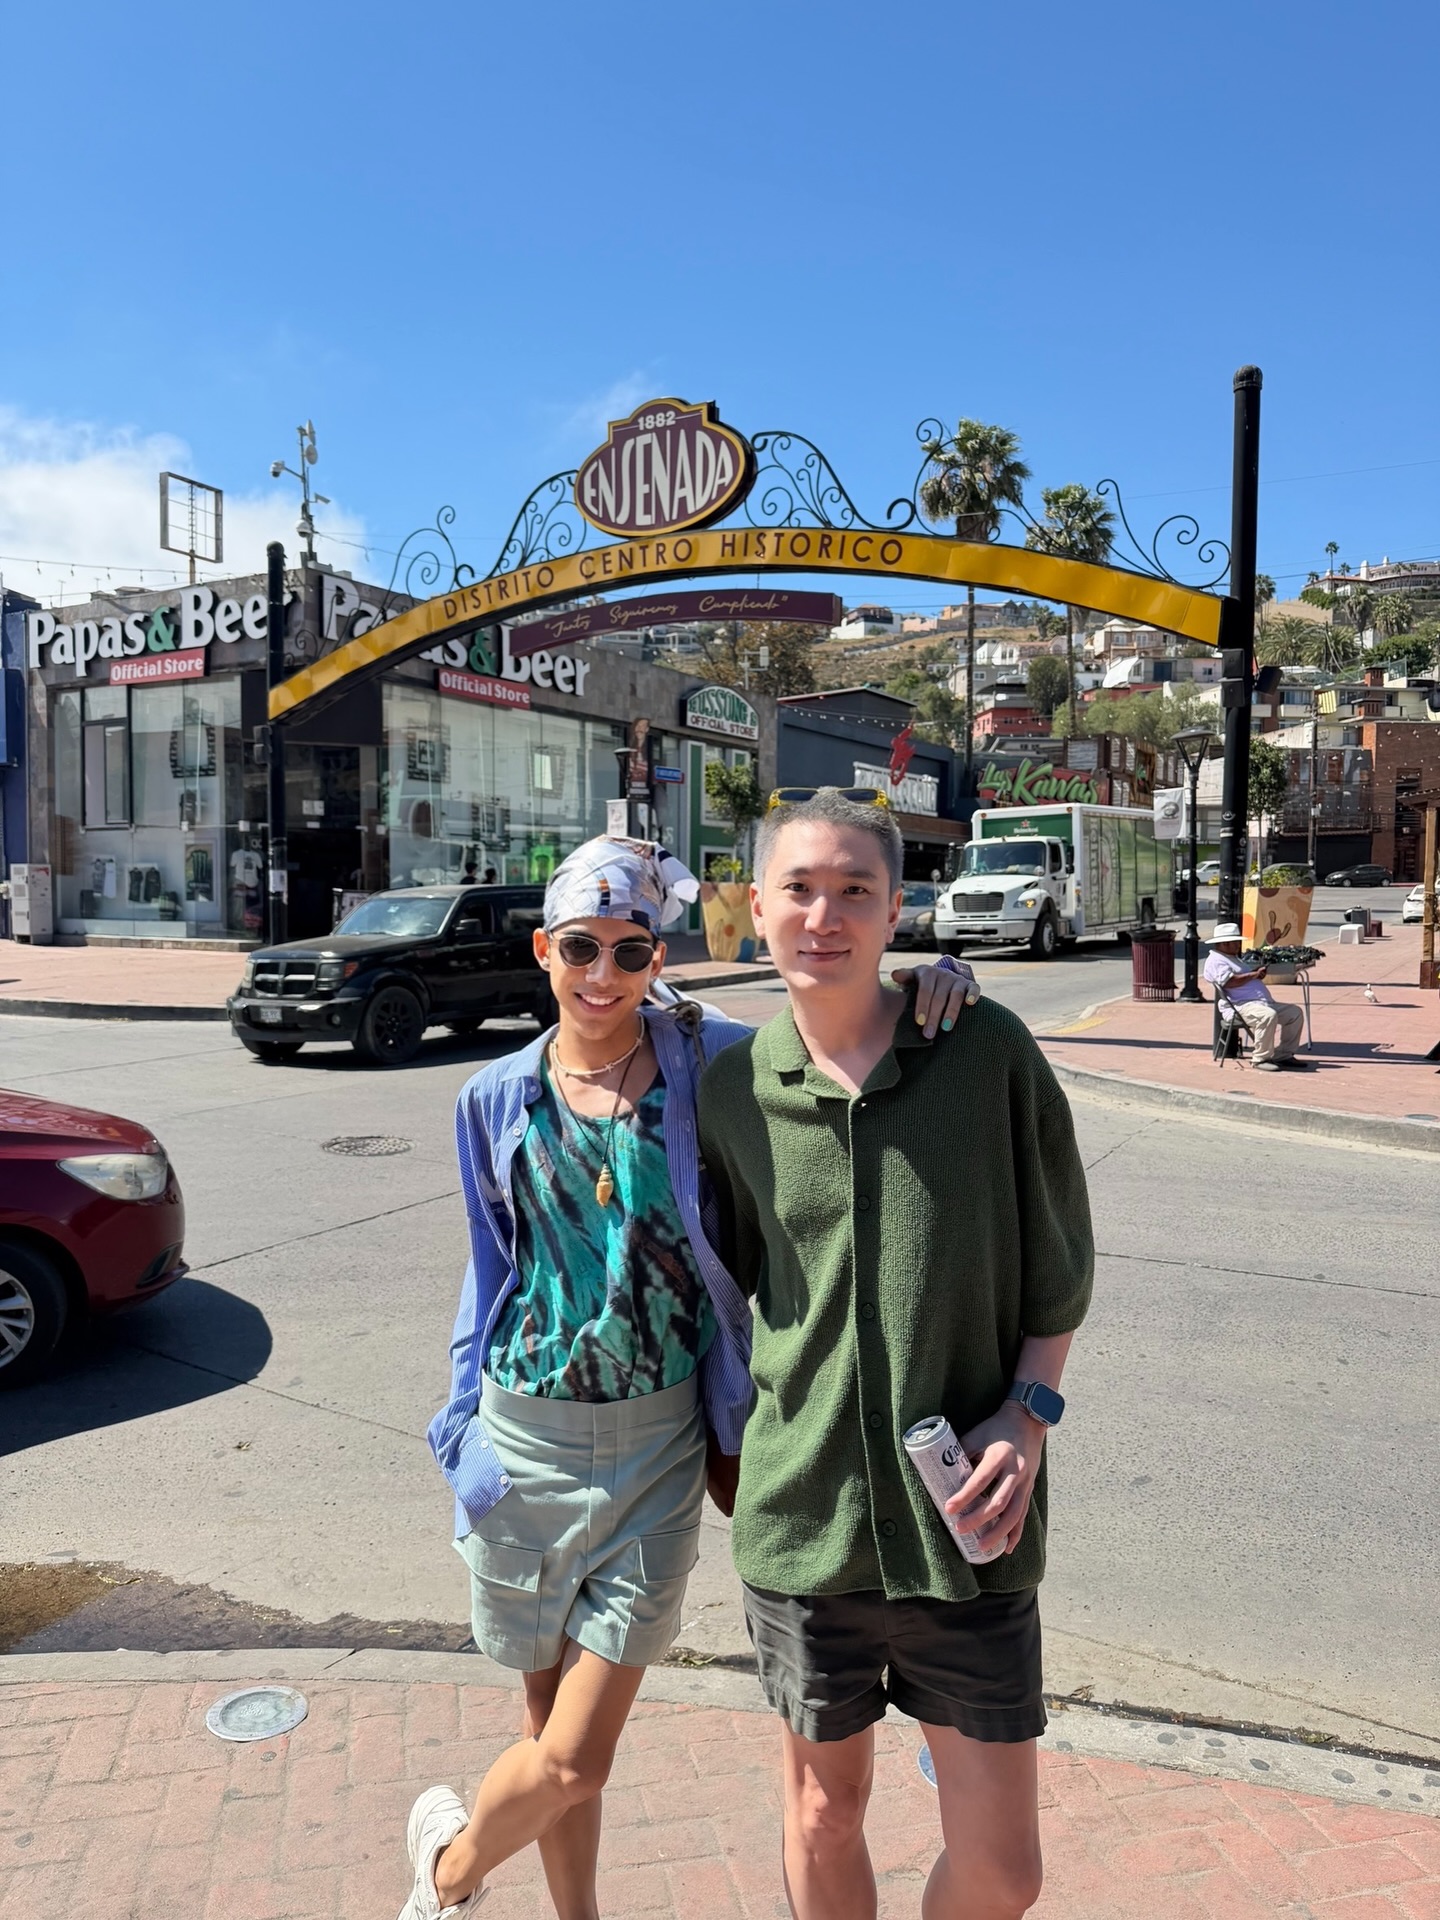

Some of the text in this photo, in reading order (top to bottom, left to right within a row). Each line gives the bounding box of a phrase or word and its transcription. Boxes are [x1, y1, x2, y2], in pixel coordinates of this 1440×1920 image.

[637, 410, 676, 431] 1882
[583, 428, 734, 526] ENSENADA
[443, 532, 903, 620] DISTRITO CENTRO HISTORICO
[111, 656, 204, 682] Official Store
[440, 671, 530, 704] Official Store
[690, 714, 756, 738] OFFICIAL STORE
